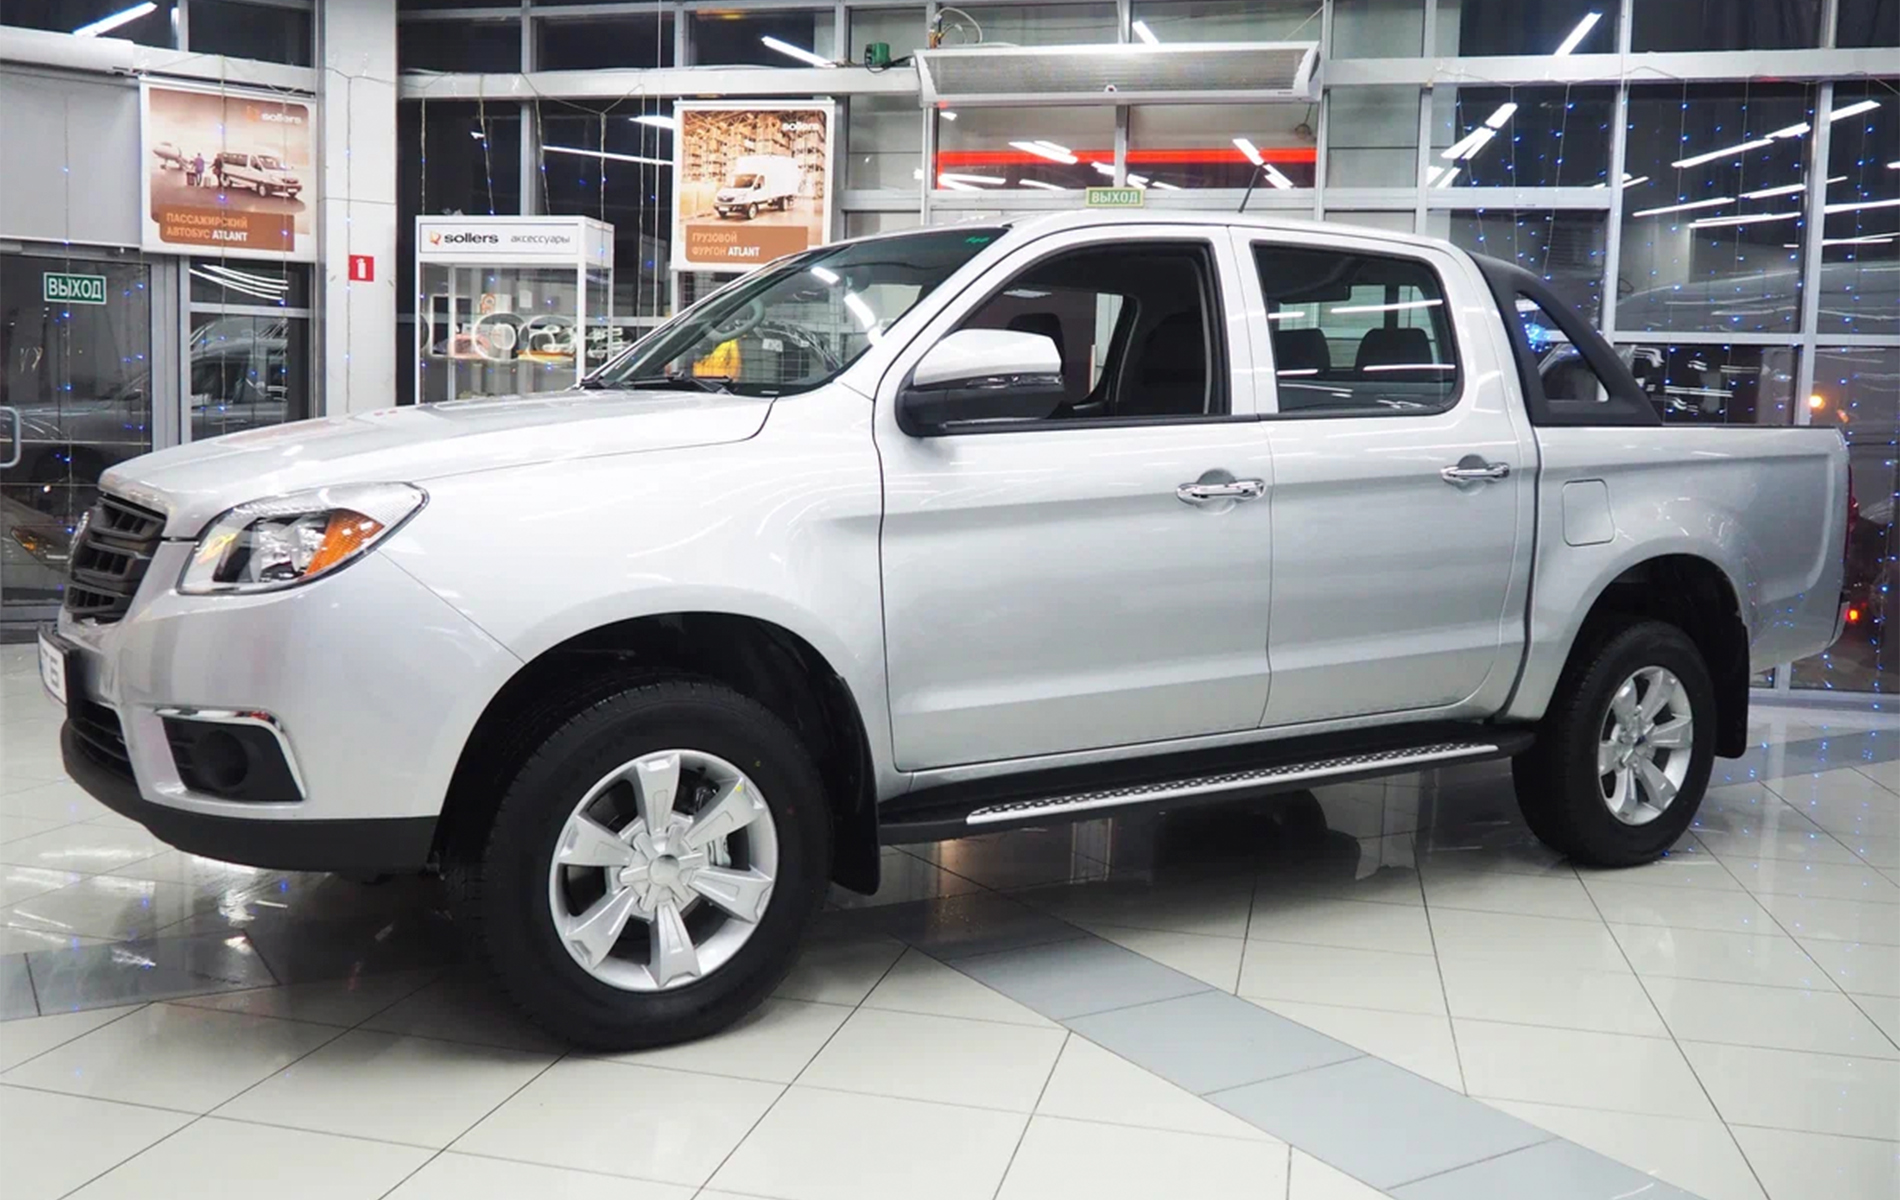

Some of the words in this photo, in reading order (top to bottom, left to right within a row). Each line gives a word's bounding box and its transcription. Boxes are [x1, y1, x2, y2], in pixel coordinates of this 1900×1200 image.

[1091, 191, 1138, 203] ВЫХОД
[166, 212, 248, 228] ПАССАЖИРСКИЙ
[166, 226, 211, 239] АВТОБУС
[212, 231, 248, 242] ATLANT
[444, 232, 499, 244] sollers
[510, 234, 570, 245] аксессуары
[692, 231, 738, 243] ГРУЗОВОЙ
[691, 241, 727, 251] ФУРГОН
[728, 246, 760, 257] ATLANT
[692, 246, 727, 256] ФУРГОН
